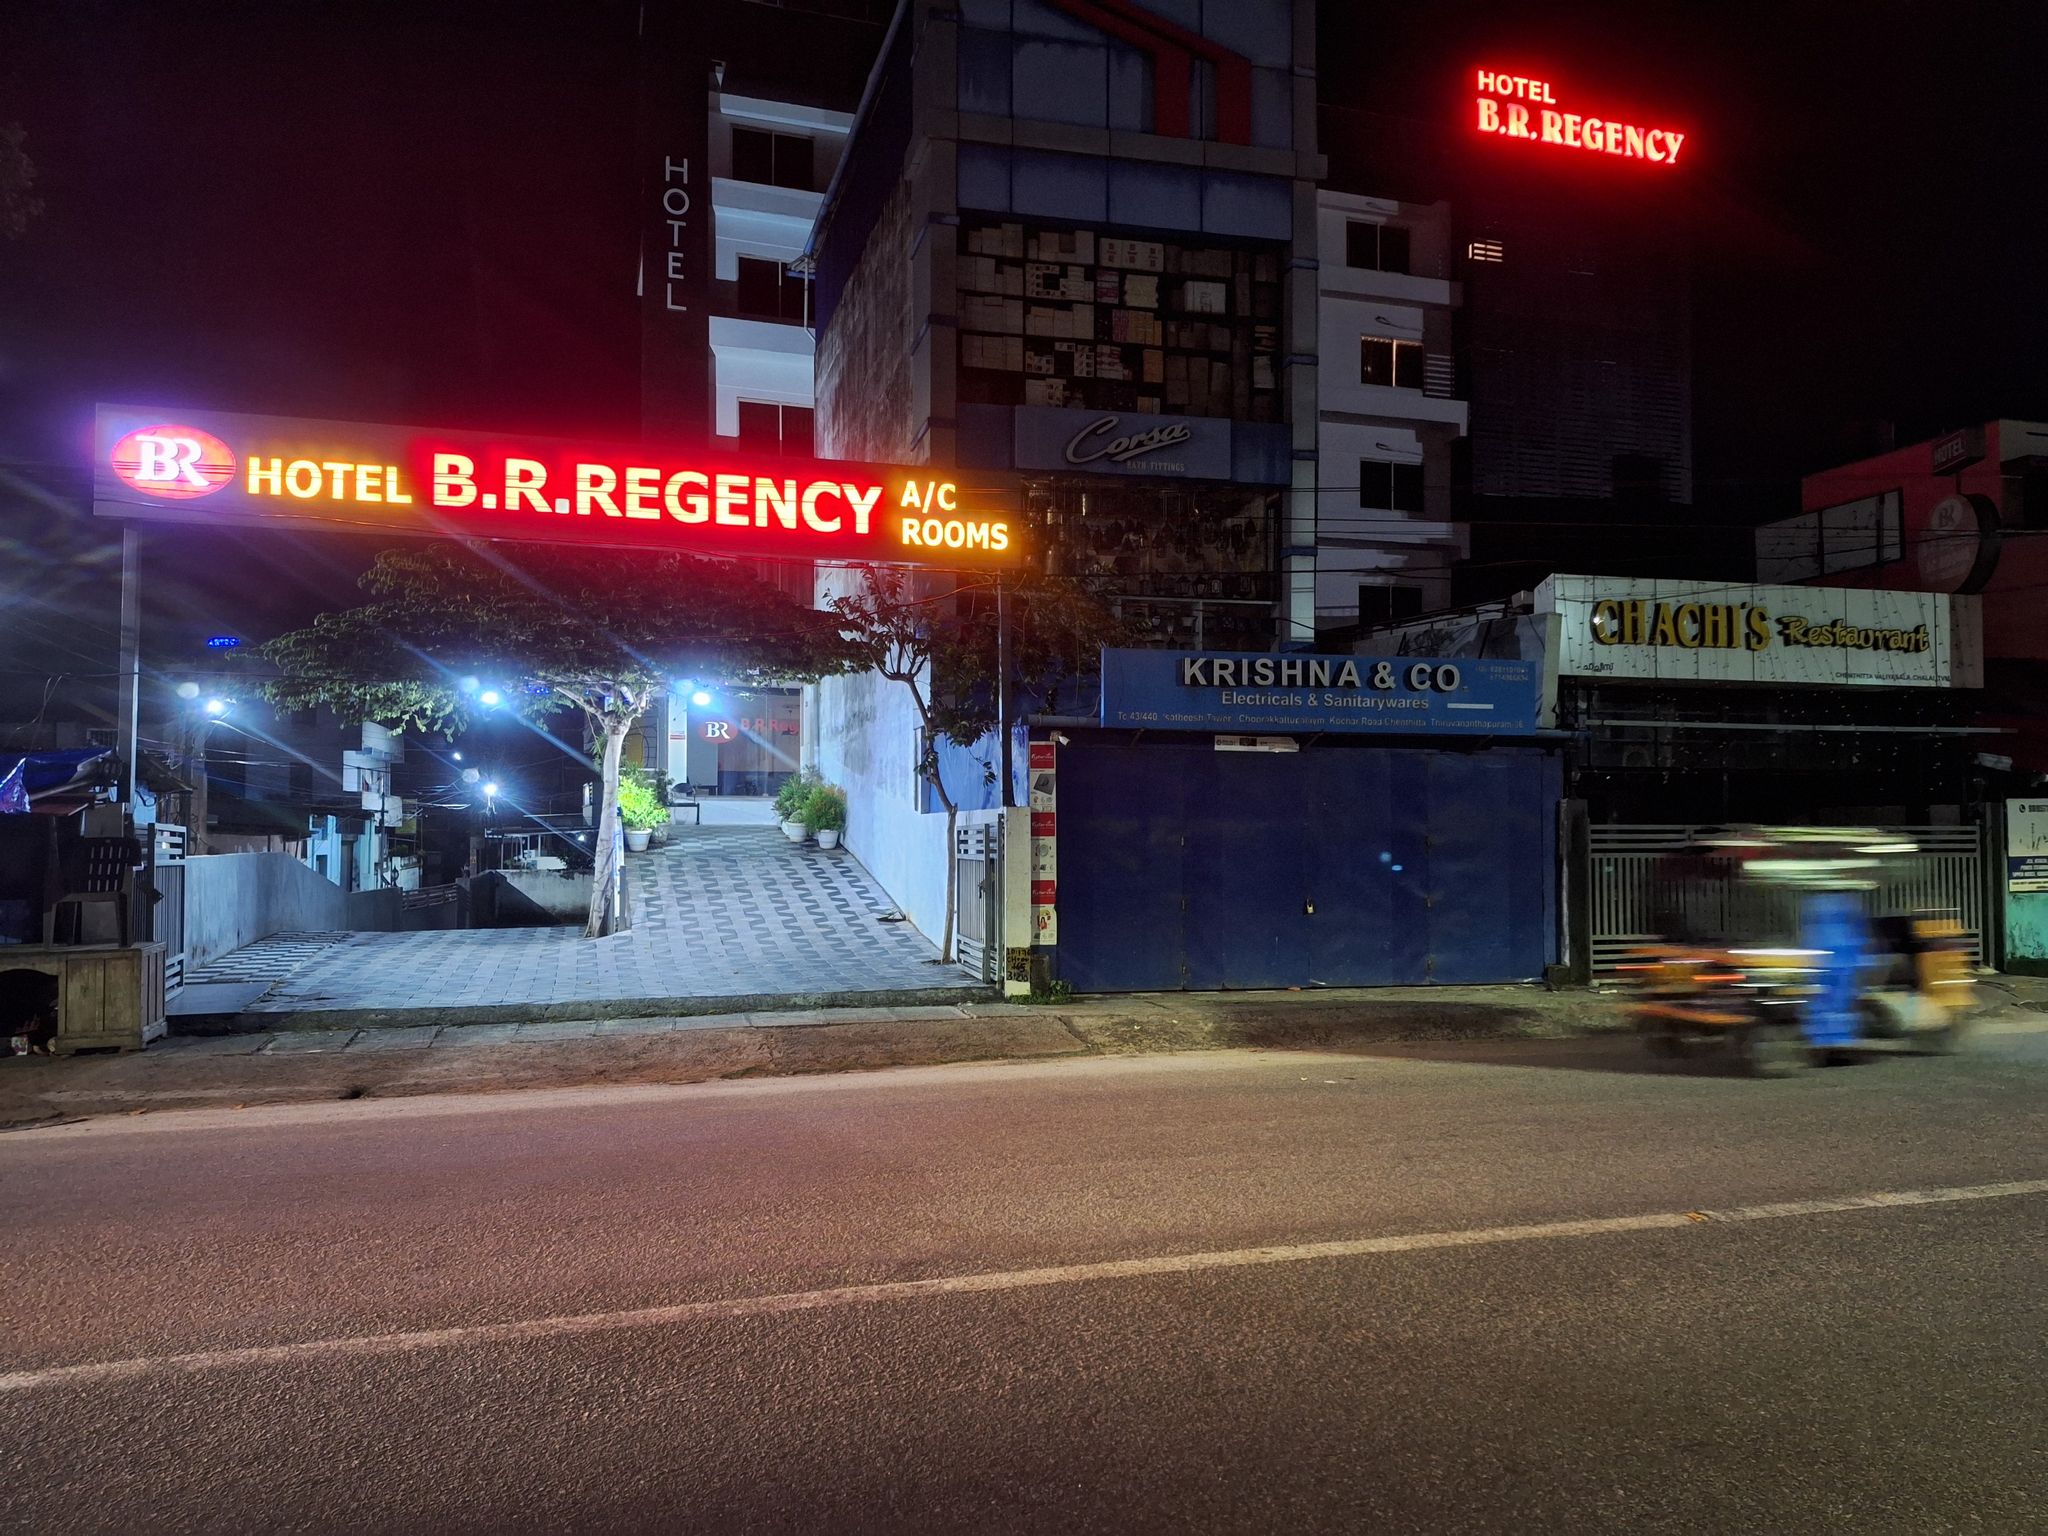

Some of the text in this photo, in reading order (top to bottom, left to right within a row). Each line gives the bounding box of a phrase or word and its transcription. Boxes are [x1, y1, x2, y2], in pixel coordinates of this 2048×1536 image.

[1477, 70, 1556, 104] HOTEL
[662, 155, 690, 311] HOTEL
[1065, 415, 1190, 464] Corsa
[134, 434, 210, 487] BR
[247, 456, 413, 504] HOTEL
[900, 480, 957, 514] A/C
[901, 517, 1009, 551] ROOMS
[1593, 599, 1931, 653] CHACHI'S Restaurant
[1182, 657, 1363, 688] KRISHNA
[1373, 661, 1397, 690] &
[1221, 691, 1429, 711] Electricals & Sanitarywares
[705, 721, 731, 739] BR
